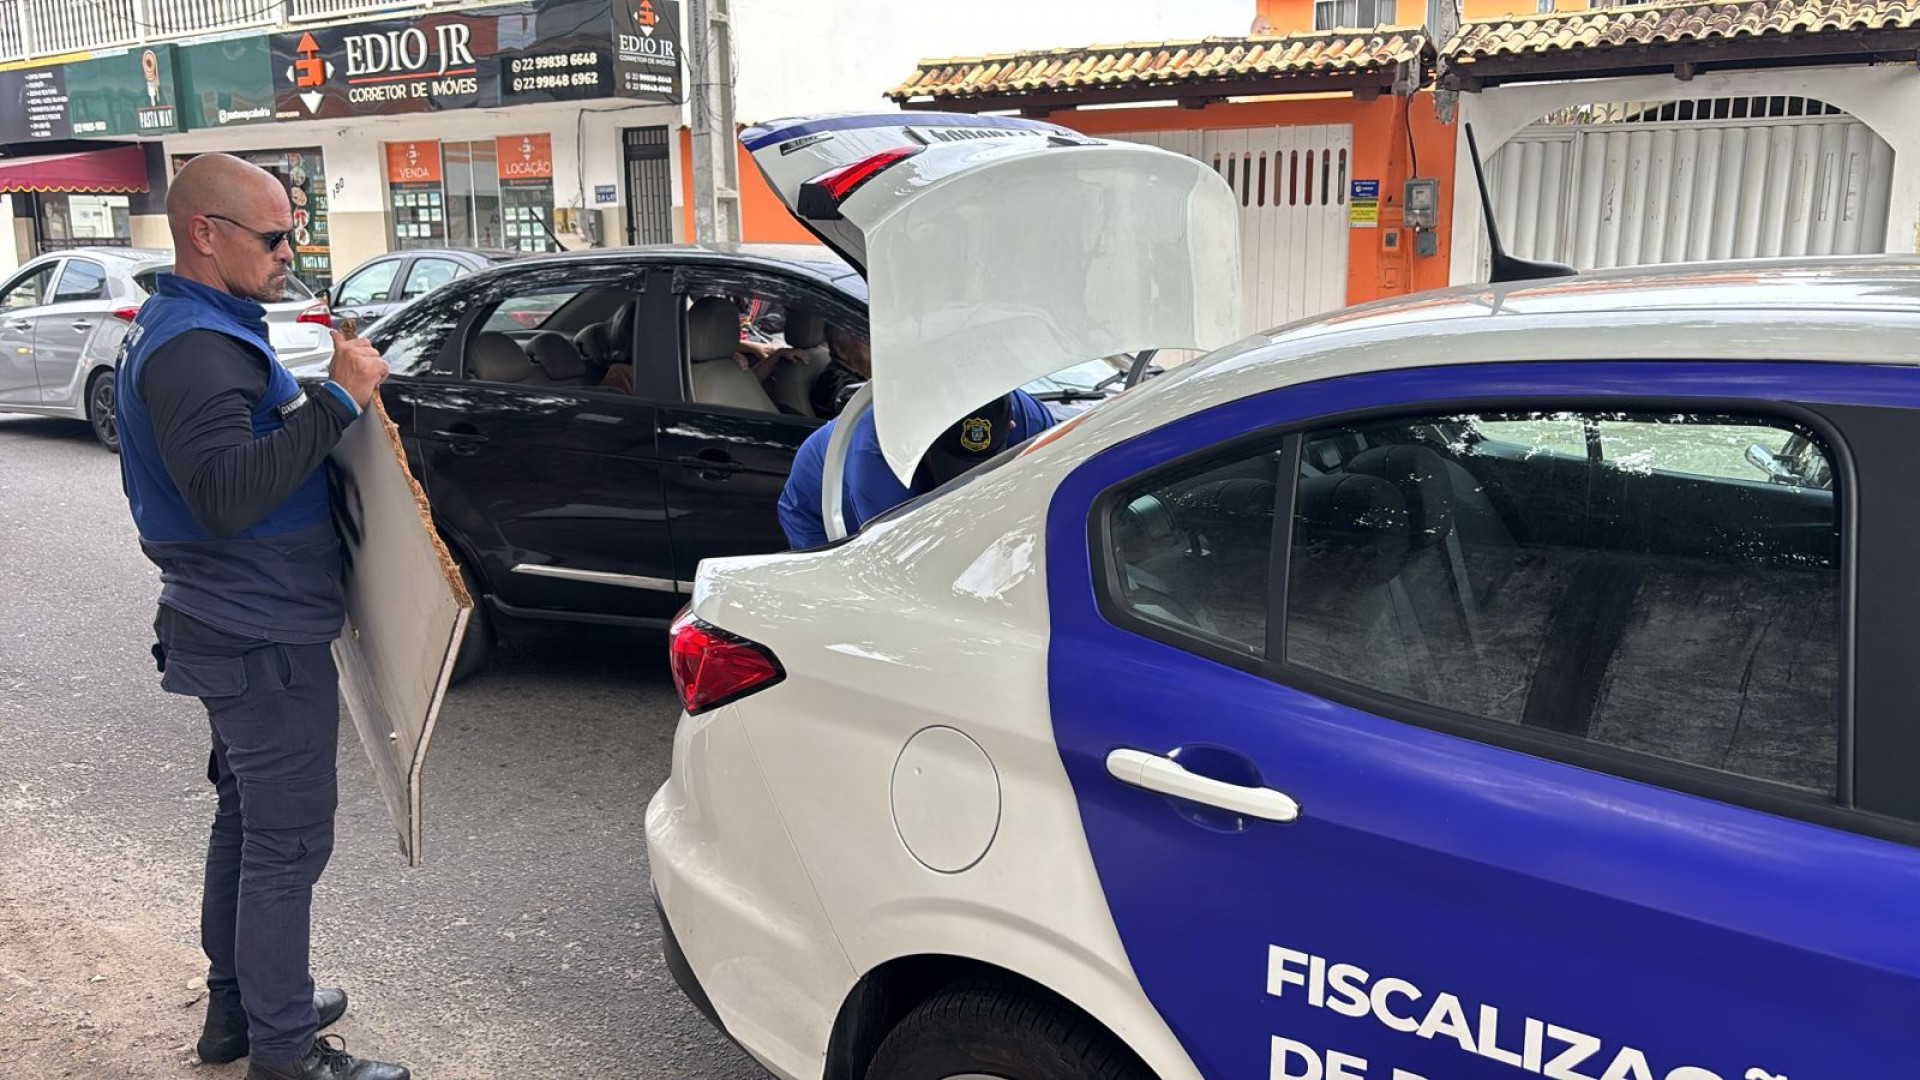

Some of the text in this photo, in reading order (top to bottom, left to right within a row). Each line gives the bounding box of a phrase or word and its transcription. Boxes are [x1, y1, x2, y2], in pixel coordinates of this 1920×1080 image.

[343, 23, 476, 75] EDIO JR
[618, 34, 675, 57] EDIO JR
[521, 52, 598, 71] 22 99838 6648
[348, 77, 478, 103] CORRETOR DE IMÓVEIS
[522, 71, 599, 90] 22 99848 6962
[400, 167, 430, 178] VENDA
[505, 160, 551, 176] LOCAÇÃO
